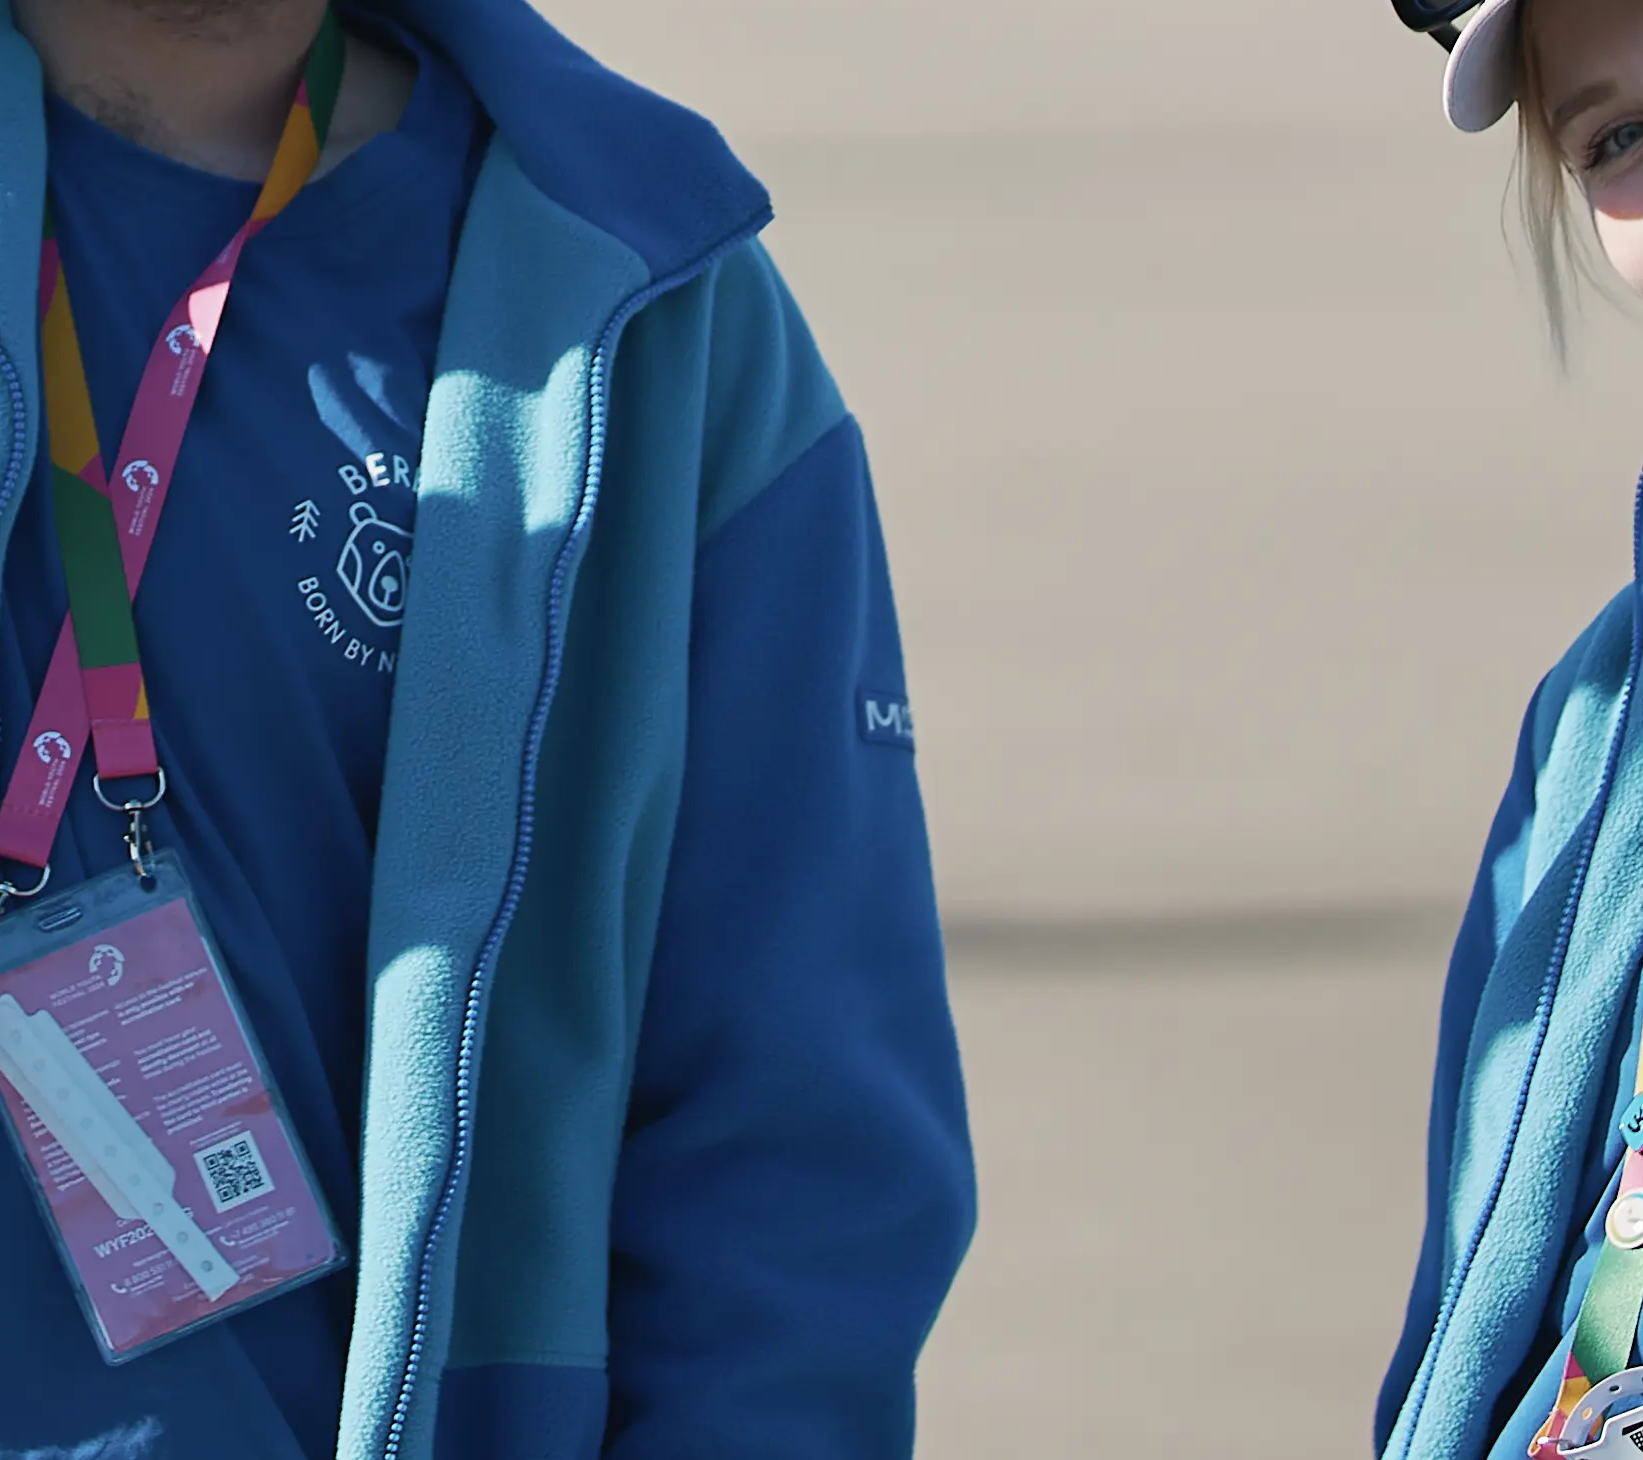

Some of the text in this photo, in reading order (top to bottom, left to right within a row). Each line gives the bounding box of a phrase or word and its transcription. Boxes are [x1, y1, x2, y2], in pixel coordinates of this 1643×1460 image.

[337, 452, 421, 495] BER
[298, 577, 346, 645] BORN
[343, 638, 375, 666] BY
[93, 1223, 156, 1260] WYF202
